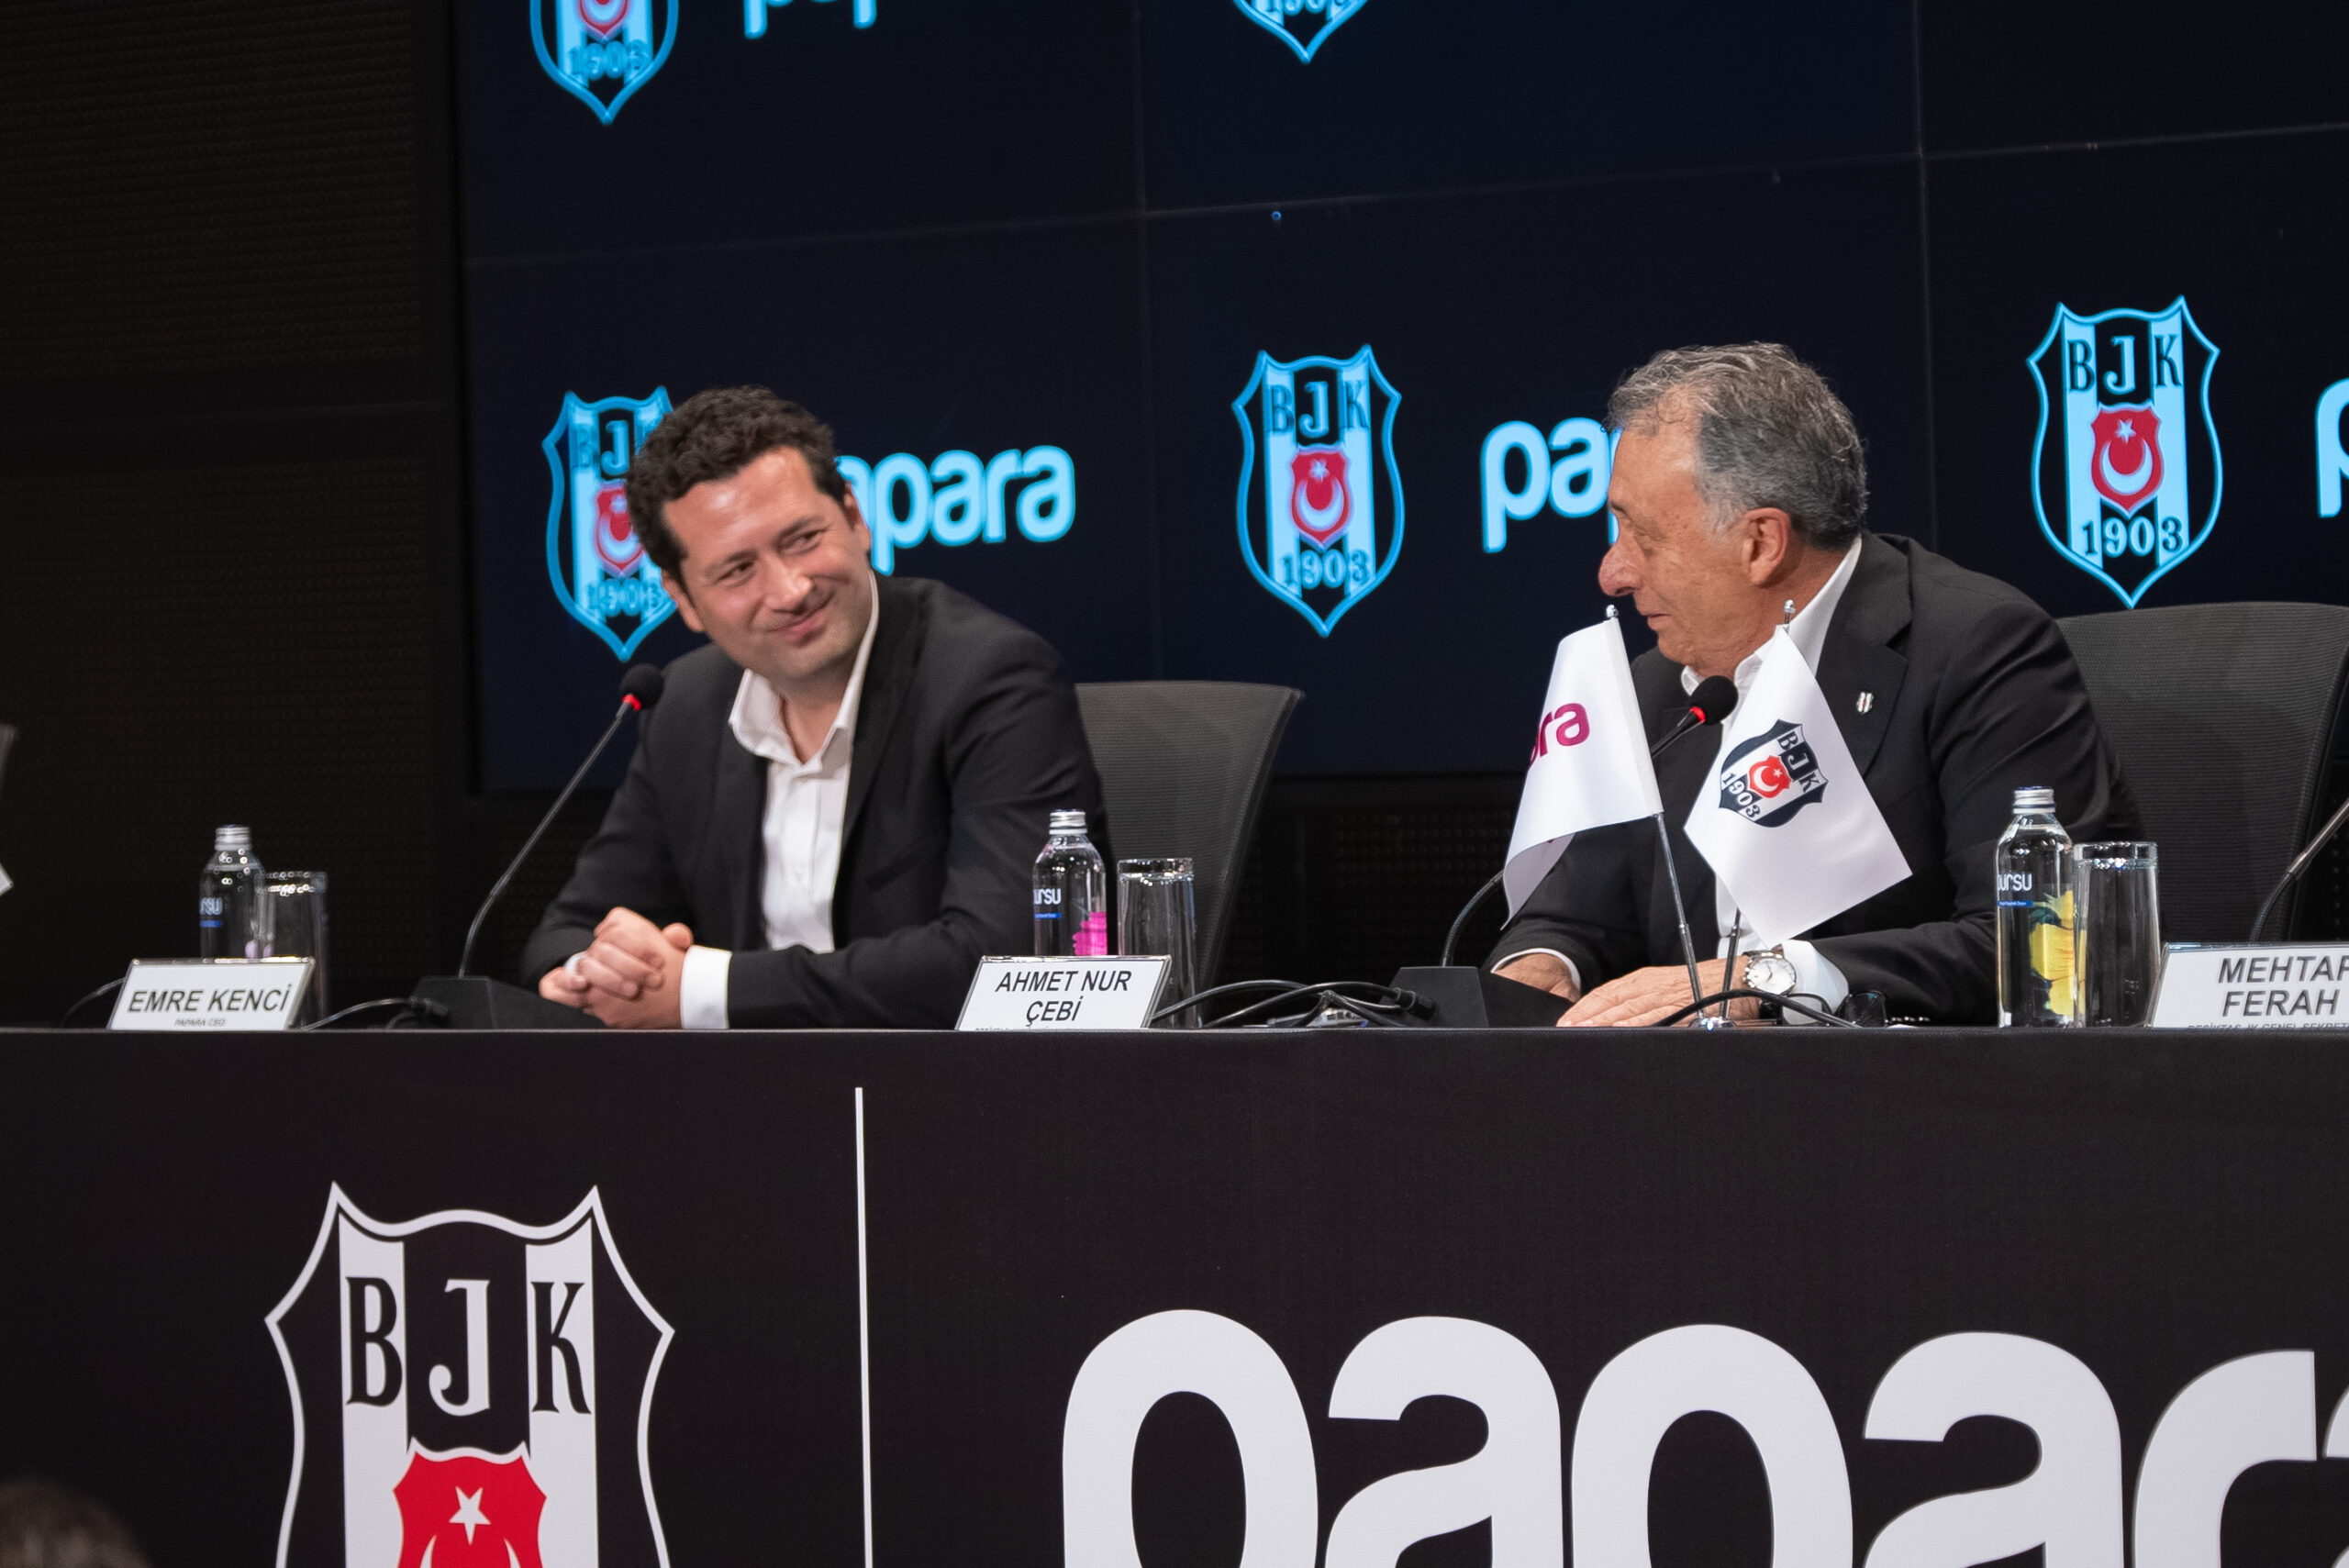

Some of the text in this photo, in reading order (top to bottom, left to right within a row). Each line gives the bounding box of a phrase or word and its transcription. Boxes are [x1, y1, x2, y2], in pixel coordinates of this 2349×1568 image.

[2066, 333, 2183, 395] BJK
[1267, 379, 1371, 439] BJK
[1480, 417, 1623, 553] pa
[2081, 516, 2183, 557] 1903
[1279, 549, 1371, 590] 1903
[1528, 702, 1590, 767] ra
[1776, 730, 1821, 794] BJK
[1721, 773, 1761, 818] 1903
[127, 983, 293, 1013] EMRE KENCİ
[995, 970, 1132, 993] AHMET NUR
[2221, 988, 2341, 1018] FERAH
[1025, 995, 1084, 1028] ÇEBİ
[344, 1275, 593, 1417] BJK
